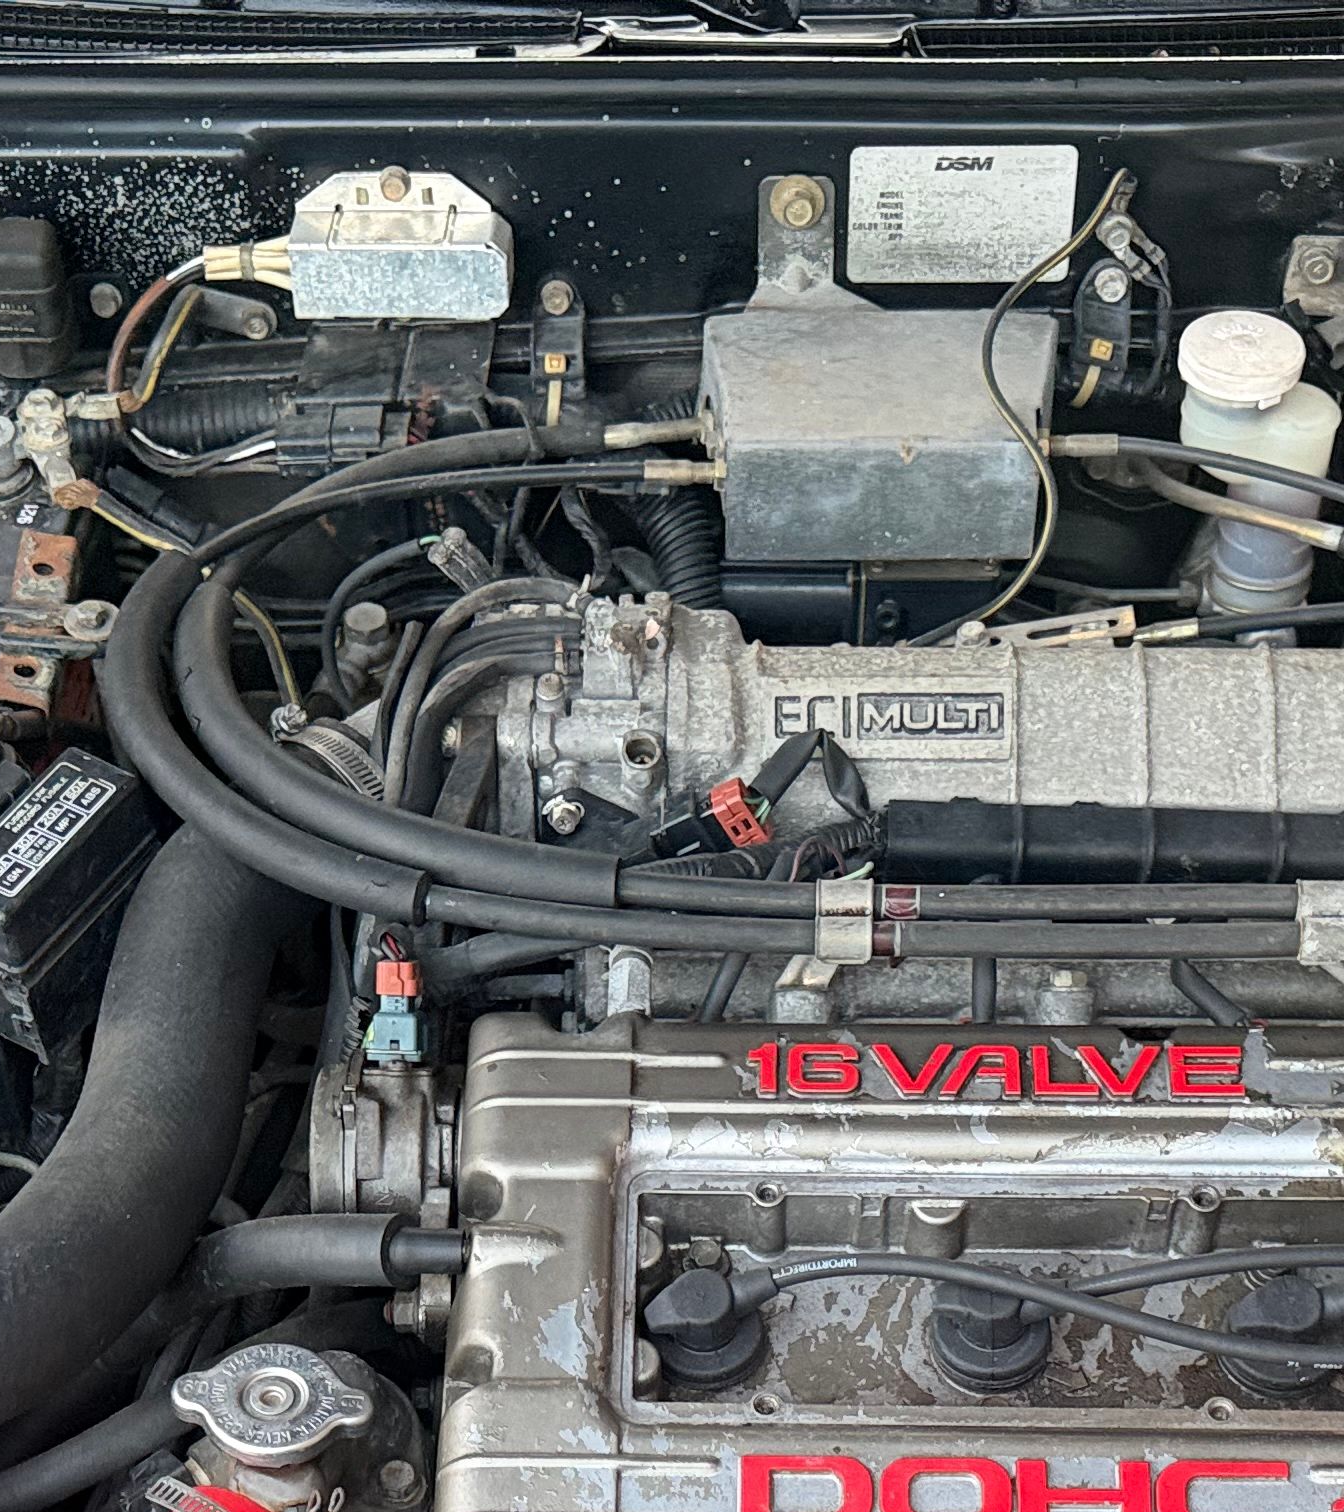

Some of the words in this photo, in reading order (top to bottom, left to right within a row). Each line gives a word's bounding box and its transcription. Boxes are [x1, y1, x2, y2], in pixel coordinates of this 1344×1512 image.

[935, 157, 994, 172] DSM
[862, 701, 1001, 732] MULTI
[79, 785, 103, 806] ABS
[3, 802, 33, 829] FUSIBLE
[39, 805, 62, 825] 20A
[747, 1042, 861, 1099] 16
[871, 1043, 1248, 1101] VALVE
